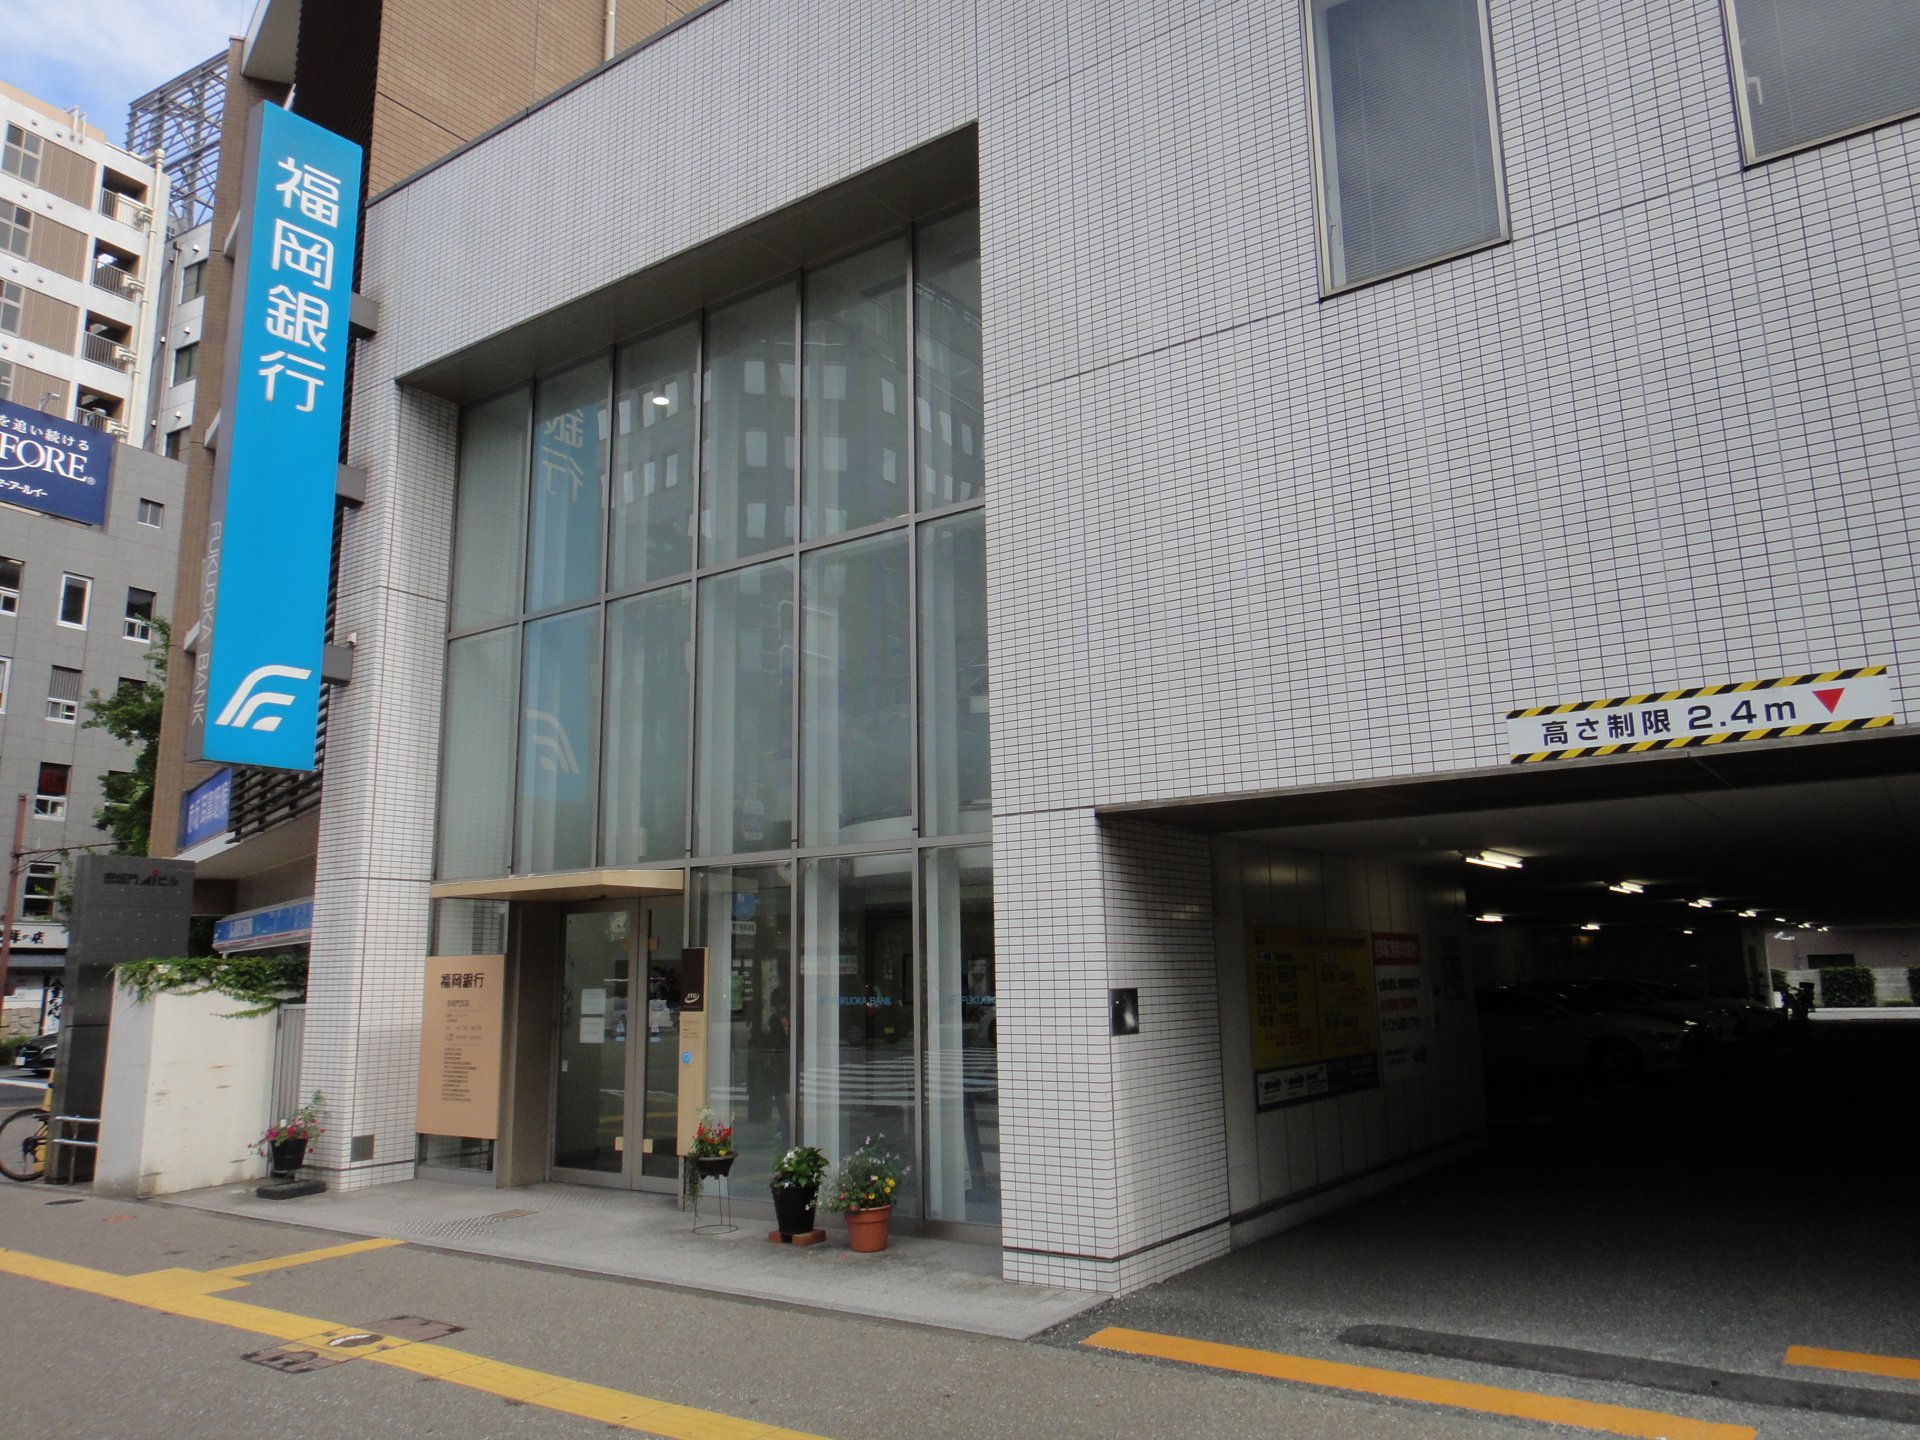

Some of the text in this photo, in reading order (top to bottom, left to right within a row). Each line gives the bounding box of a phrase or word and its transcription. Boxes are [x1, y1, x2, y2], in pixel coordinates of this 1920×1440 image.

[258, 156, 341, 413] 福岡銀行
[191, 520, 222, 727] FUKUOKA BANK
[1542, 699, 1797, 747] 高さ制限 2.4m
[440, 972, 486, 989] 福岡銀行
